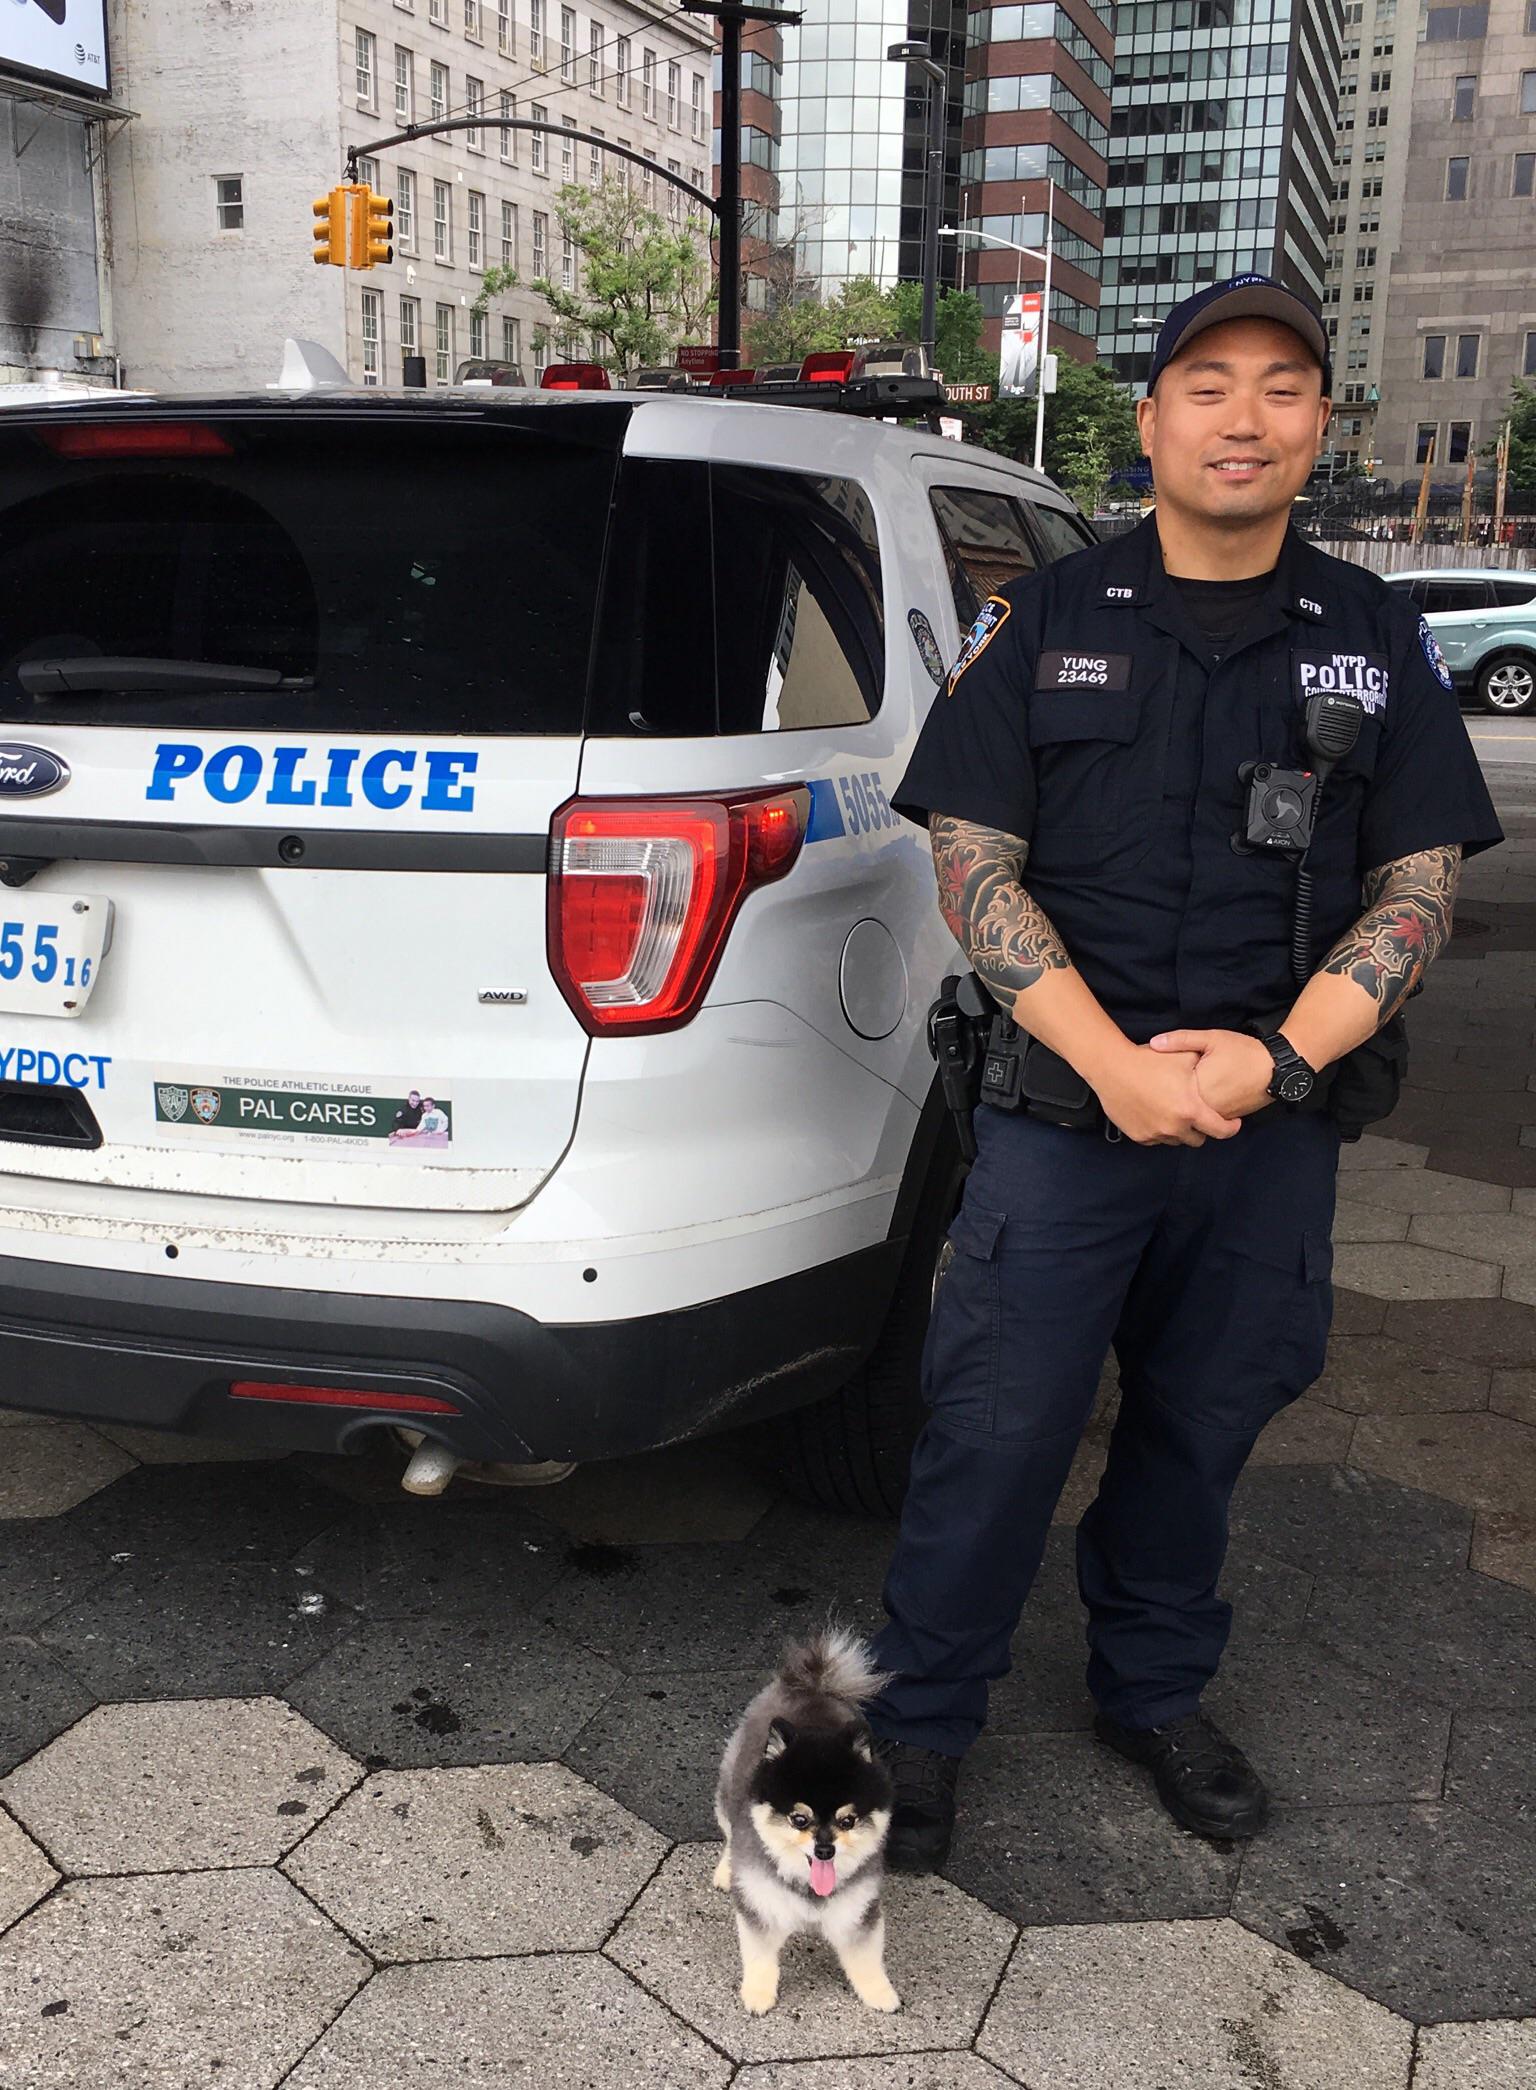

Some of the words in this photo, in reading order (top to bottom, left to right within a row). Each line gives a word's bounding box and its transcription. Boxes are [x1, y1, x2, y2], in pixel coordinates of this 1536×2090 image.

[945, 387, 973, 401] OUTH
[975, 386, 989, 400] ST
[1106, 587, 1133, 598] CTB
[1300, 598, 1322, 615] CTB
[1062, 656, 1108, 672] YUNG
[1332, 654, 1367, 667] NYPD
[1057, 670, 1108, 685] 23469
[146, 744, 479, 812] POLICE
[839, 772, 892, 835] 5055
[482, 991, 524, 1000] AWD
[223, 1076, 241, 1086] THE
[244, 1078, 279, 1089] POLICE
[281, 1080, 328, 1092] ATHLETIC
[331, 1083, 372, 1095] LEAGUE
[240, 1097, 284, 1120] PAL
[290, 1101, 377, 1126] CARES
